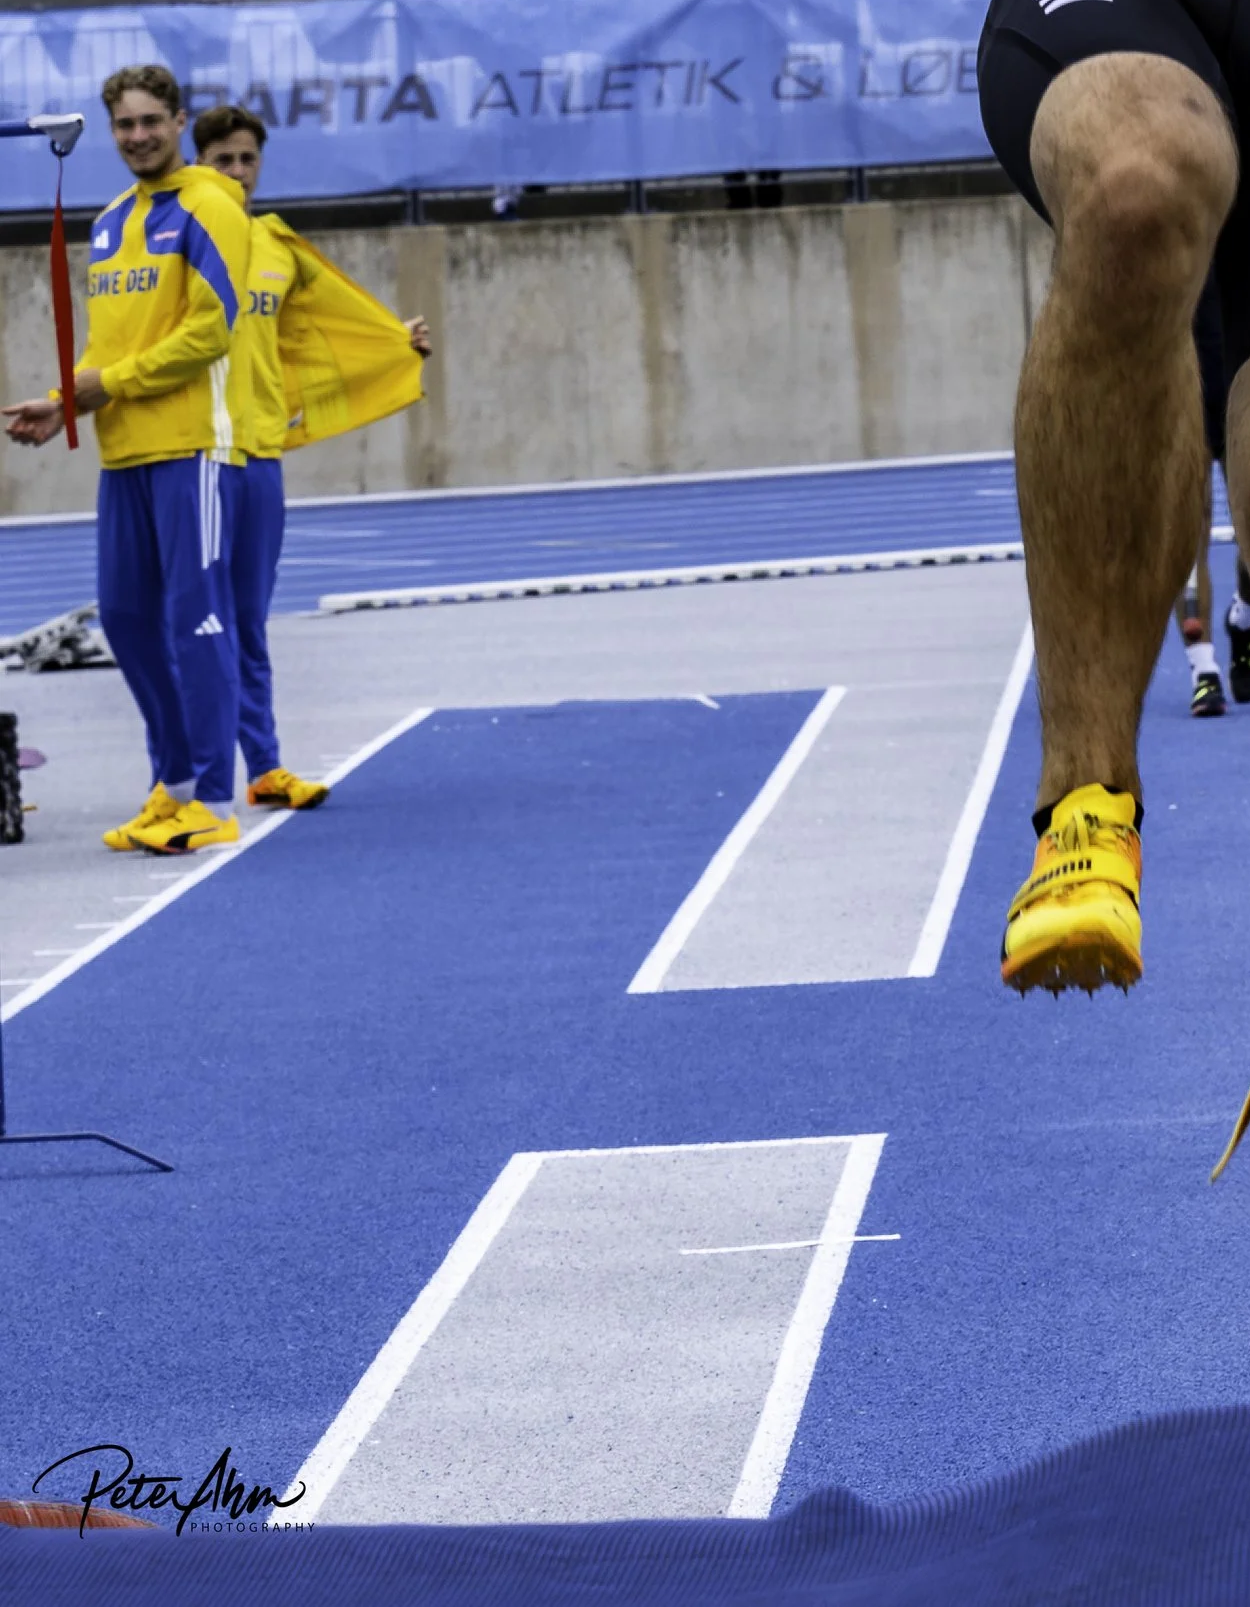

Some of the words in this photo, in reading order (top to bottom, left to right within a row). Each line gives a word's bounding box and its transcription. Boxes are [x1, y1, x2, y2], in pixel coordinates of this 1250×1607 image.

[183, 73, 438, 127] PARTA
[470, 56, 746, 120] ATLETIK
[772, 53, 824, 102] &
